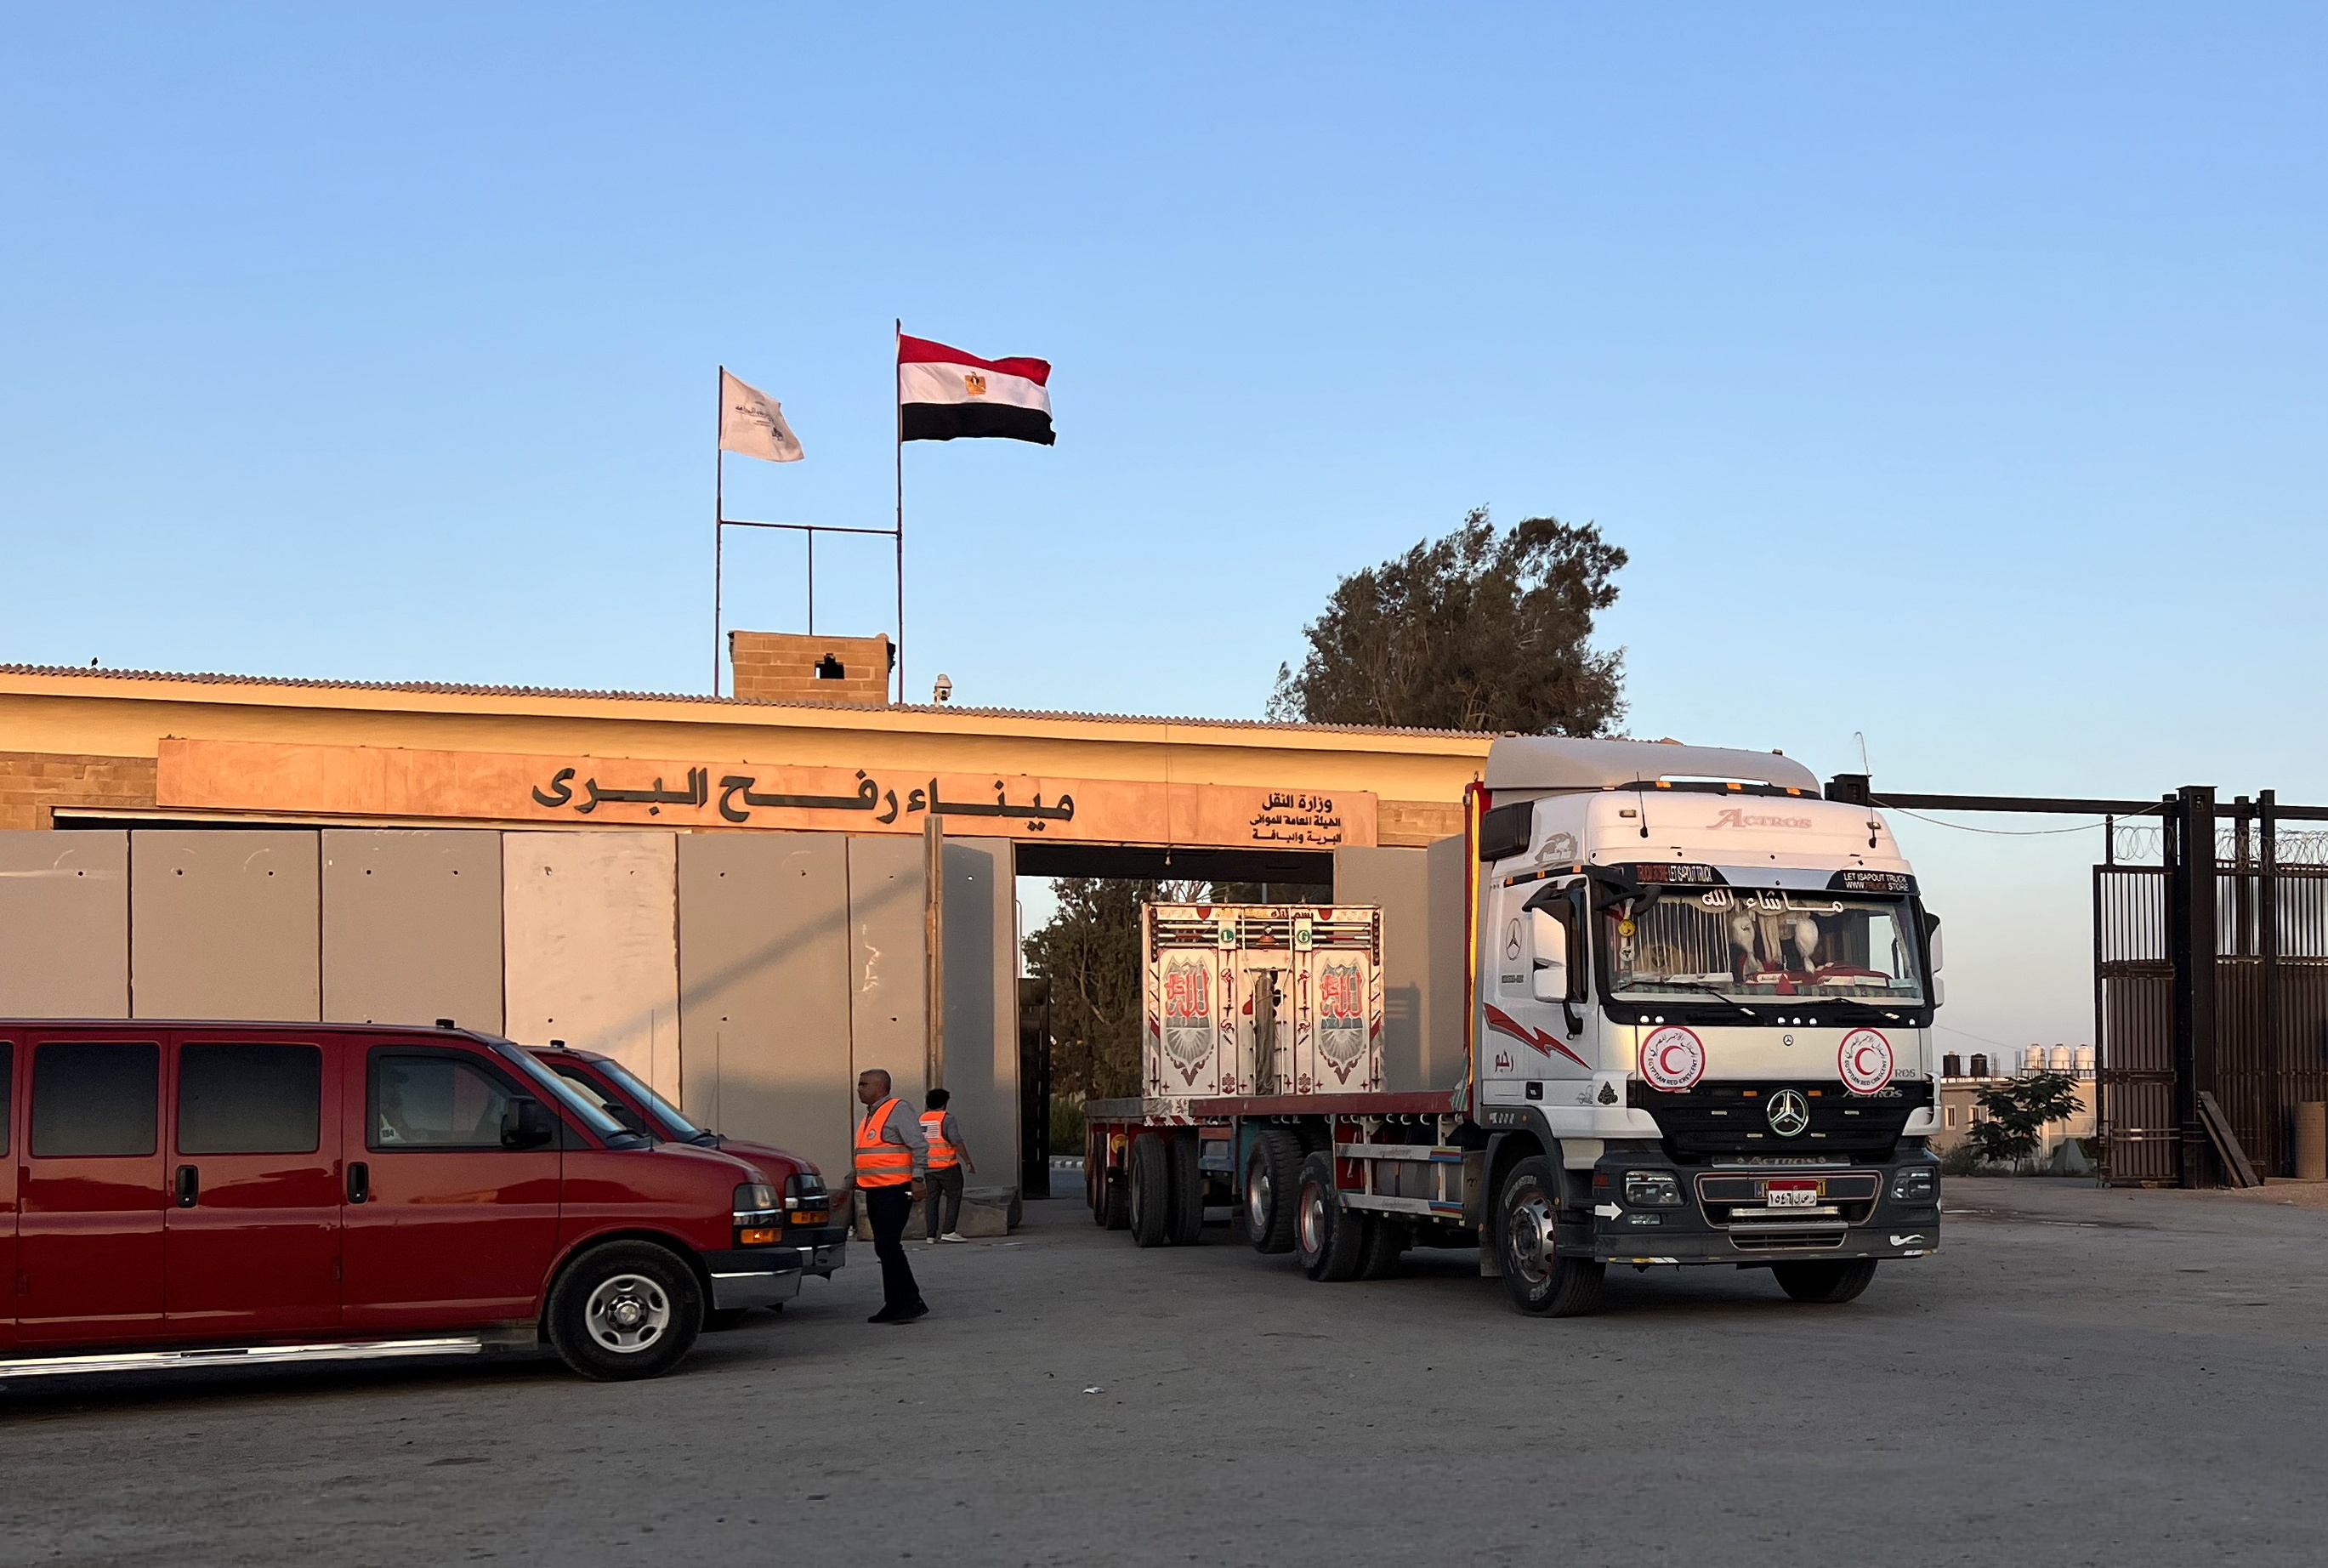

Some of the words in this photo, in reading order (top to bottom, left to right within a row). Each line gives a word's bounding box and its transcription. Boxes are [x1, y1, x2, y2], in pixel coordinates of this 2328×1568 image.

[718, 769, 899, 824] رفح
[906, 775, 1075, 832] ميناء
[1262, 793, 1294, 811] النقل
[1298, 793, 1332, 813] وزارة
[1285, 815, 1312, 826] العامة
[1843, 872, 1856, 881] LET
[1888, 882, 1910, 892] STORE
[1702, 889, 1734, 906] الله
[1746, 890, 1782, 910] شاء
[1781, 891, 1843, 912] ما
[1648, 1058, 1667, 1083] EGYPTIAN
[1678, 1059, 1698, 1084] CRESCENT
[1844, 1060, 1860, 1084] EGYPTIAN
[1871, 1060, 1887, 1084] CRESCENT
[1895, 1068, 1916, 1078] ROS
